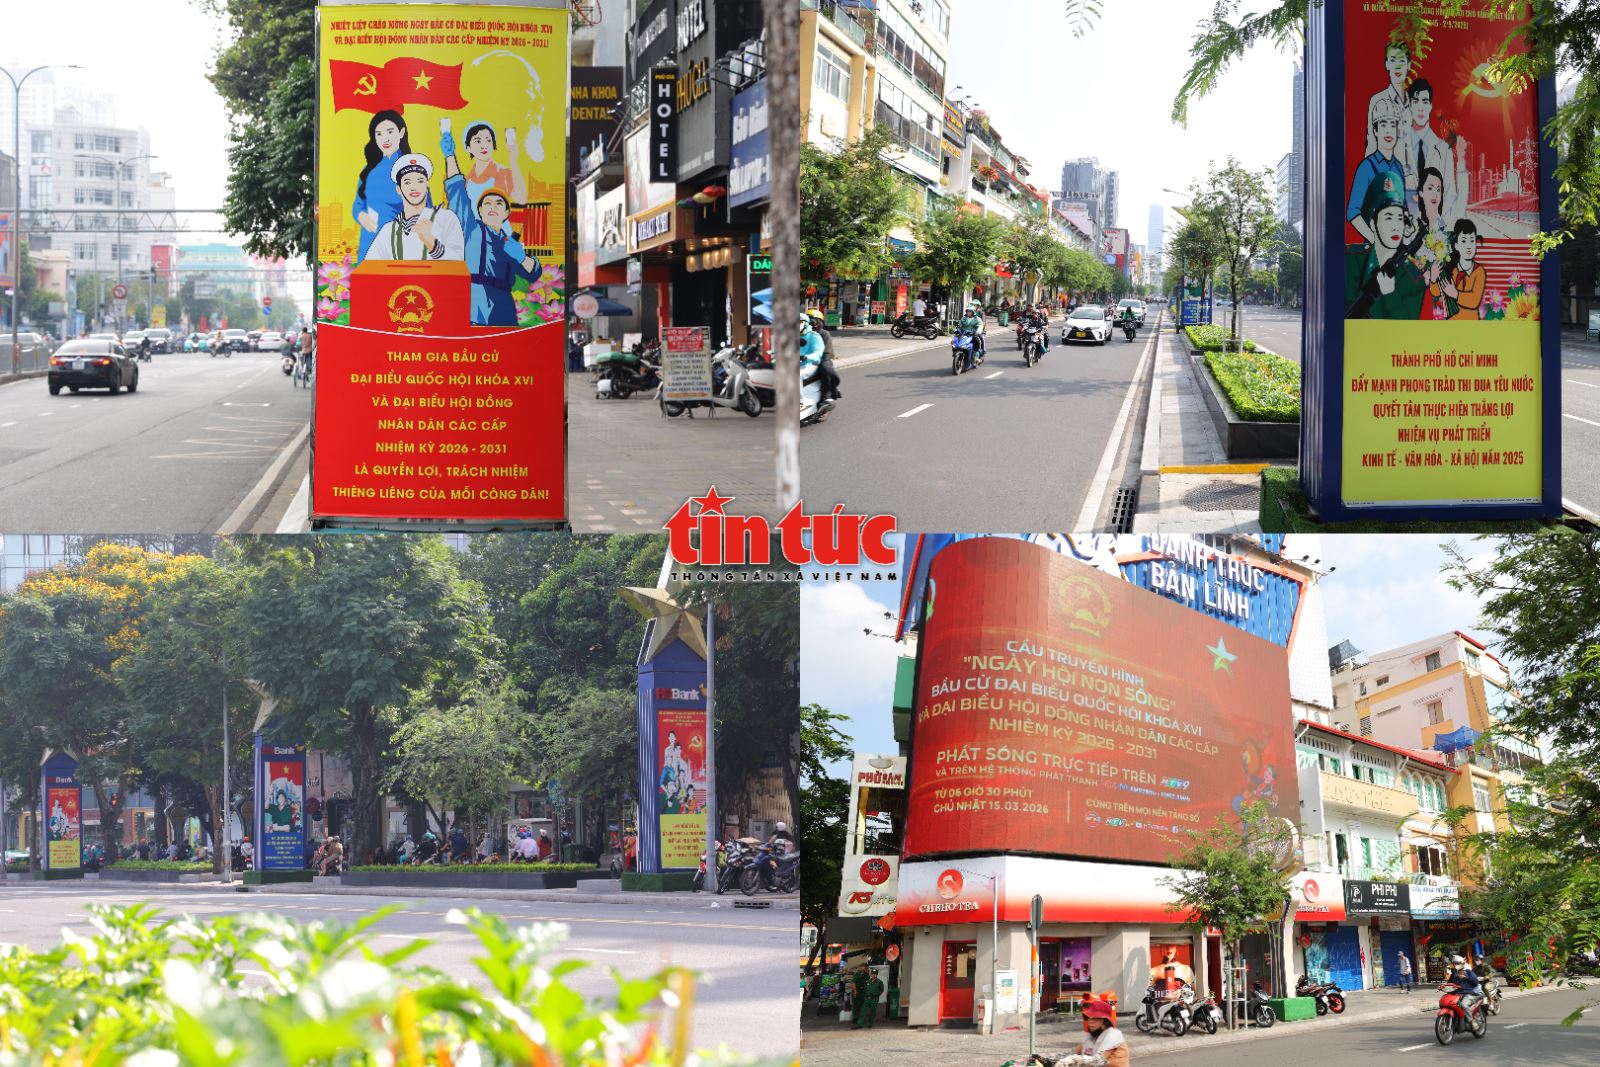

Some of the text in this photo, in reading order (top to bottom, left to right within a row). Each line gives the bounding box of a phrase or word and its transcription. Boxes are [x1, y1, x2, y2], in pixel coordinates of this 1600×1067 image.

[571, 86, 618, 100] NHA KHOA
[657, 83, 672, 177] HOTEL
[387, 346, 500, 363] THAM GIA BẦU CỬ
[1392, 350, 1498, 368] THÀNH PHỐ HỒ CHÍ MINH
[350, 368, 535, 388] ĐẠI BIỂU QUỐC HỘI KHÓA XVI
[1351, 372, 1369, 392] ĐẨY
[1371, 379, 1398, 396] MẠNH
[1400, 379, 1431, 392] PHONG
[1433, 375, 1456, 392] TRÀO
[1458, 379, 1472, 392] THI
[1494, 374, 1509, 392] YÊU
[1512, 374, 1534, 392] NƯỚC
[372, 392, 514, 411] VÀ ĐẠI BIỂU HỘI ĐỒNG
[1373, 398, 1514, 420] QUYẾT TÂM THỰC HIỆN THẮNG LỢI
[378, 416, 508, 432] NHÂN DÂN CÁC CẤP
[1398, 422, 1491, 446] NHIỆM VỤ PHÁT TRIỂN
[376, 440, 508, 455] NHIỆM KỲ 2026 2031
[1362, 449, 1524, 469] KINH TẾ VĂN HÓA XÃ HỘI NĂM 2025
[354, 460, 529, 480] LÀ QUYỀN LỢI, TRÁCH NHIỆM
[332, 485, 550, 500] THIÊNG LIÊNG CỦA MỖI CÔNG DÂN!
[1151, 561, 1249, 620] BẢN LĨNH
[964, 654, 1037, 674] "NGÀY
[1042, 664, 1076, 686] HỘI
[1081, 674, 1120, 698] NON
[1112, 668, 1144, 686] HÌNH
[932, 676, 960, 698] BẦU
[965, 674, 992, 690] CỬ
[994, 678, 1026, 694] ĐẠI
[1032, 681, 1070, 702] BIỂU
[1074, 693, 1115, 715] QUỐC
[1118, 705, 1142, 722] HỘI
[1183, 722, 1202, 737] XVI
[932, 699, 956, 716] ĐẠI
[960, 692, 1003, 711] BIỂU
[1009, 698, 1040, 717] HỘI
[1044, 704, 1090, 726] ĐỒNG
[1094, 718, 1135, 736] NHÂN
[1138, 728, 1166, 744] DÂN
[1168, 733, 1193, 750] CÁC
[1196, 741, 1218, 756] CẤP
[990, 716, 1158, 760] NHIỆM KỲ 2026 2031
[936, 744, 980, 764] PHÁT
[986, 745, 1038, 764] SÓNG
[1042, 753, 1084, 774] TRỰC
[1088, 761, 1118, 778] TIẾP
[1122, 768, 1157, 785] TRÊN
[936, 766, 947, 777] VÀ
[950, 764, 976, 776] TRÊN
[980, 764, 994, 776] HỆ
[1040, 769, 1064, 782] PHÁT
[1067, 775, 1098, 787] THANH
[936, 784, 1034, 800] TỪ 06 GIỜ 30 PHÚT
[934, 799, 954, 814] CHỦ
[956, 798, 986, 812] NHẬT
[1114, 802, 1134, 814] TRÊN
[1136, 806, 1151, 816] MỌI
[958, 901, 980, 911] TEA
